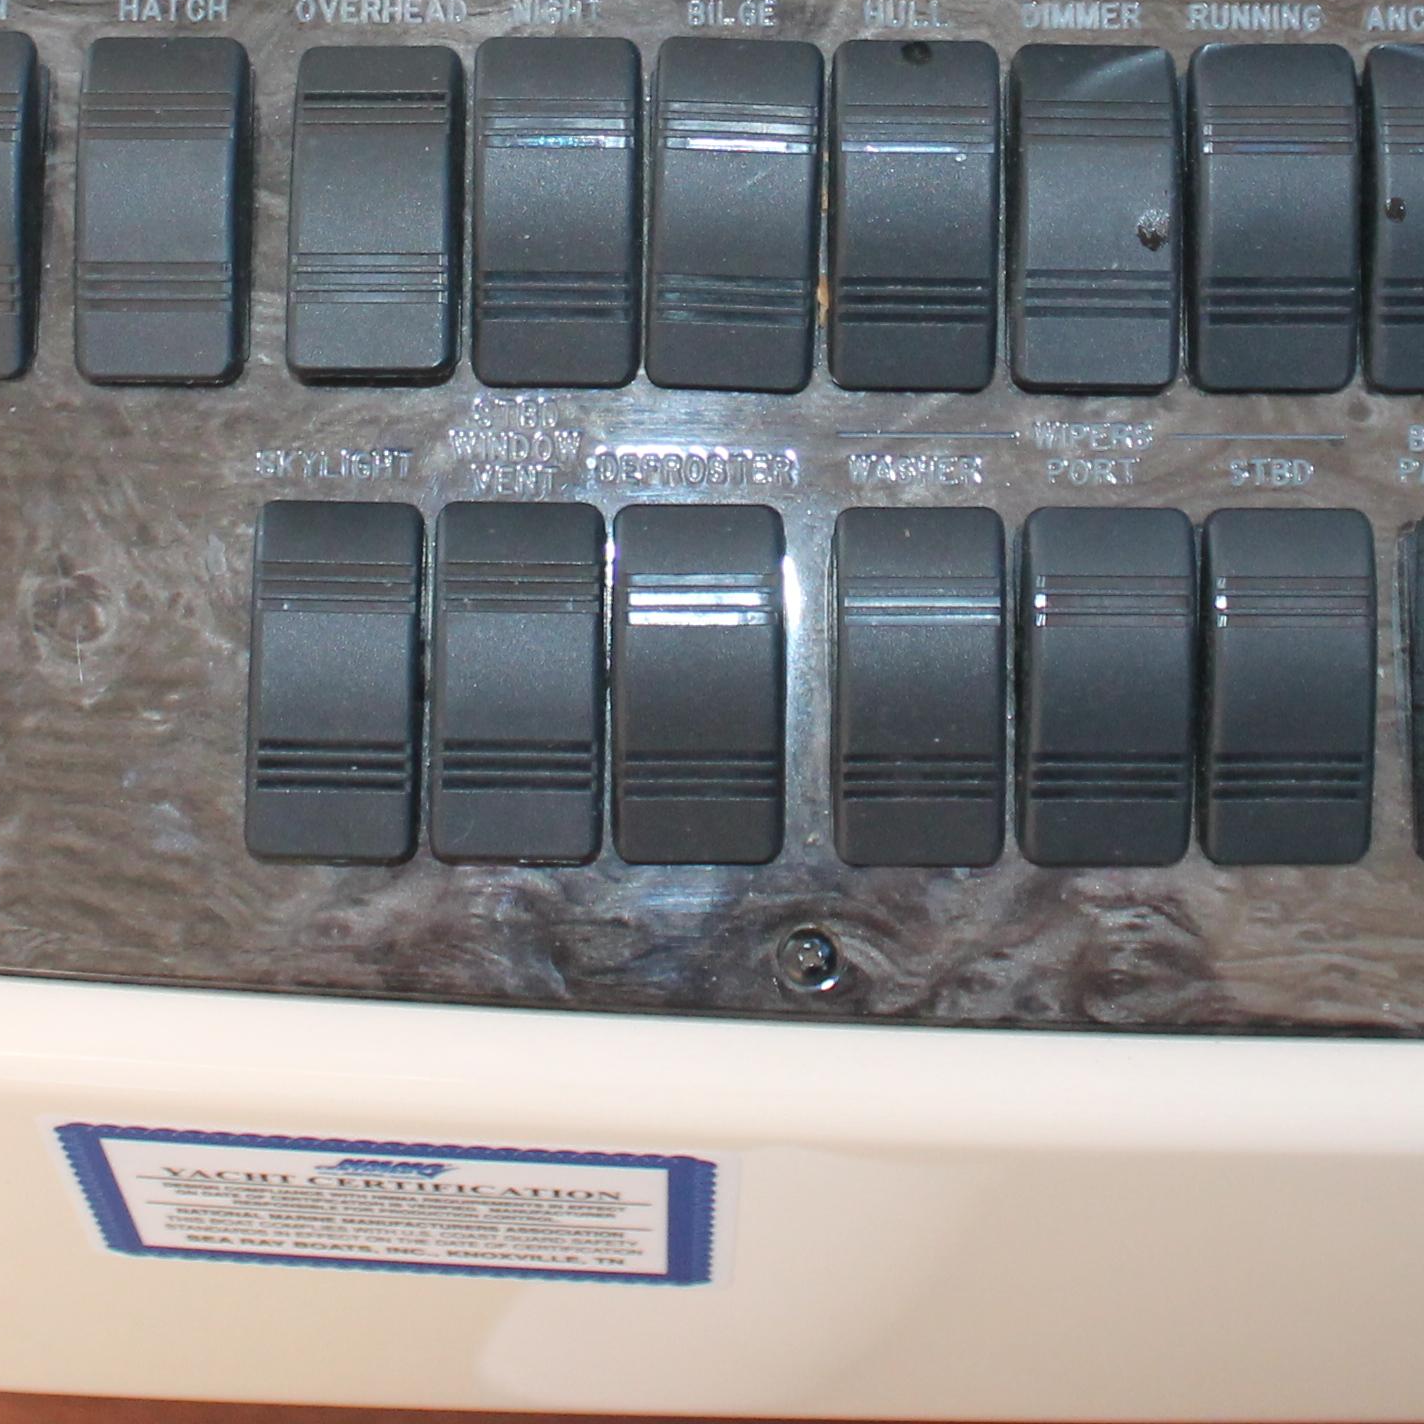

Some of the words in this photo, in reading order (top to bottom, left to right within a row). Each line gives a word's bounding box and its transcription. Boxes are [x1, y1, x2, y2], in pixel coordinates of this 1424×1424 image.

[863, 0, 949, 29] HULL
[1022, 1, 1142, 30] DIMMER
[1185, 2, 1324, 33] RUNNING
[473, 396, 559, 427] STBD
[449, 429, 583, 462] WINDOW
[1032, 421, 1155, 450] WIPERS
[256, 448, 414, 478] SKYLIGHT
[849, 454, 983, 485] WASHER
[1046, 457, 1140, 485] PORT
[1229, 458, 1314, 486] STBD
[471, 464, 560, 498] VENT
[162, 1166, 296, 1184] YACHT
[307, 1176, 622, 1201] CERTIFICATION
[176, 1207, 259, 1219] NATIONAL
[506, 1226, 624, 1240] ASSOCIATION
[187, 1234, 233, 1244] SEA
[239, 1237, 285, 1247] RAY
[593, 1257, 625, 1265] TN
